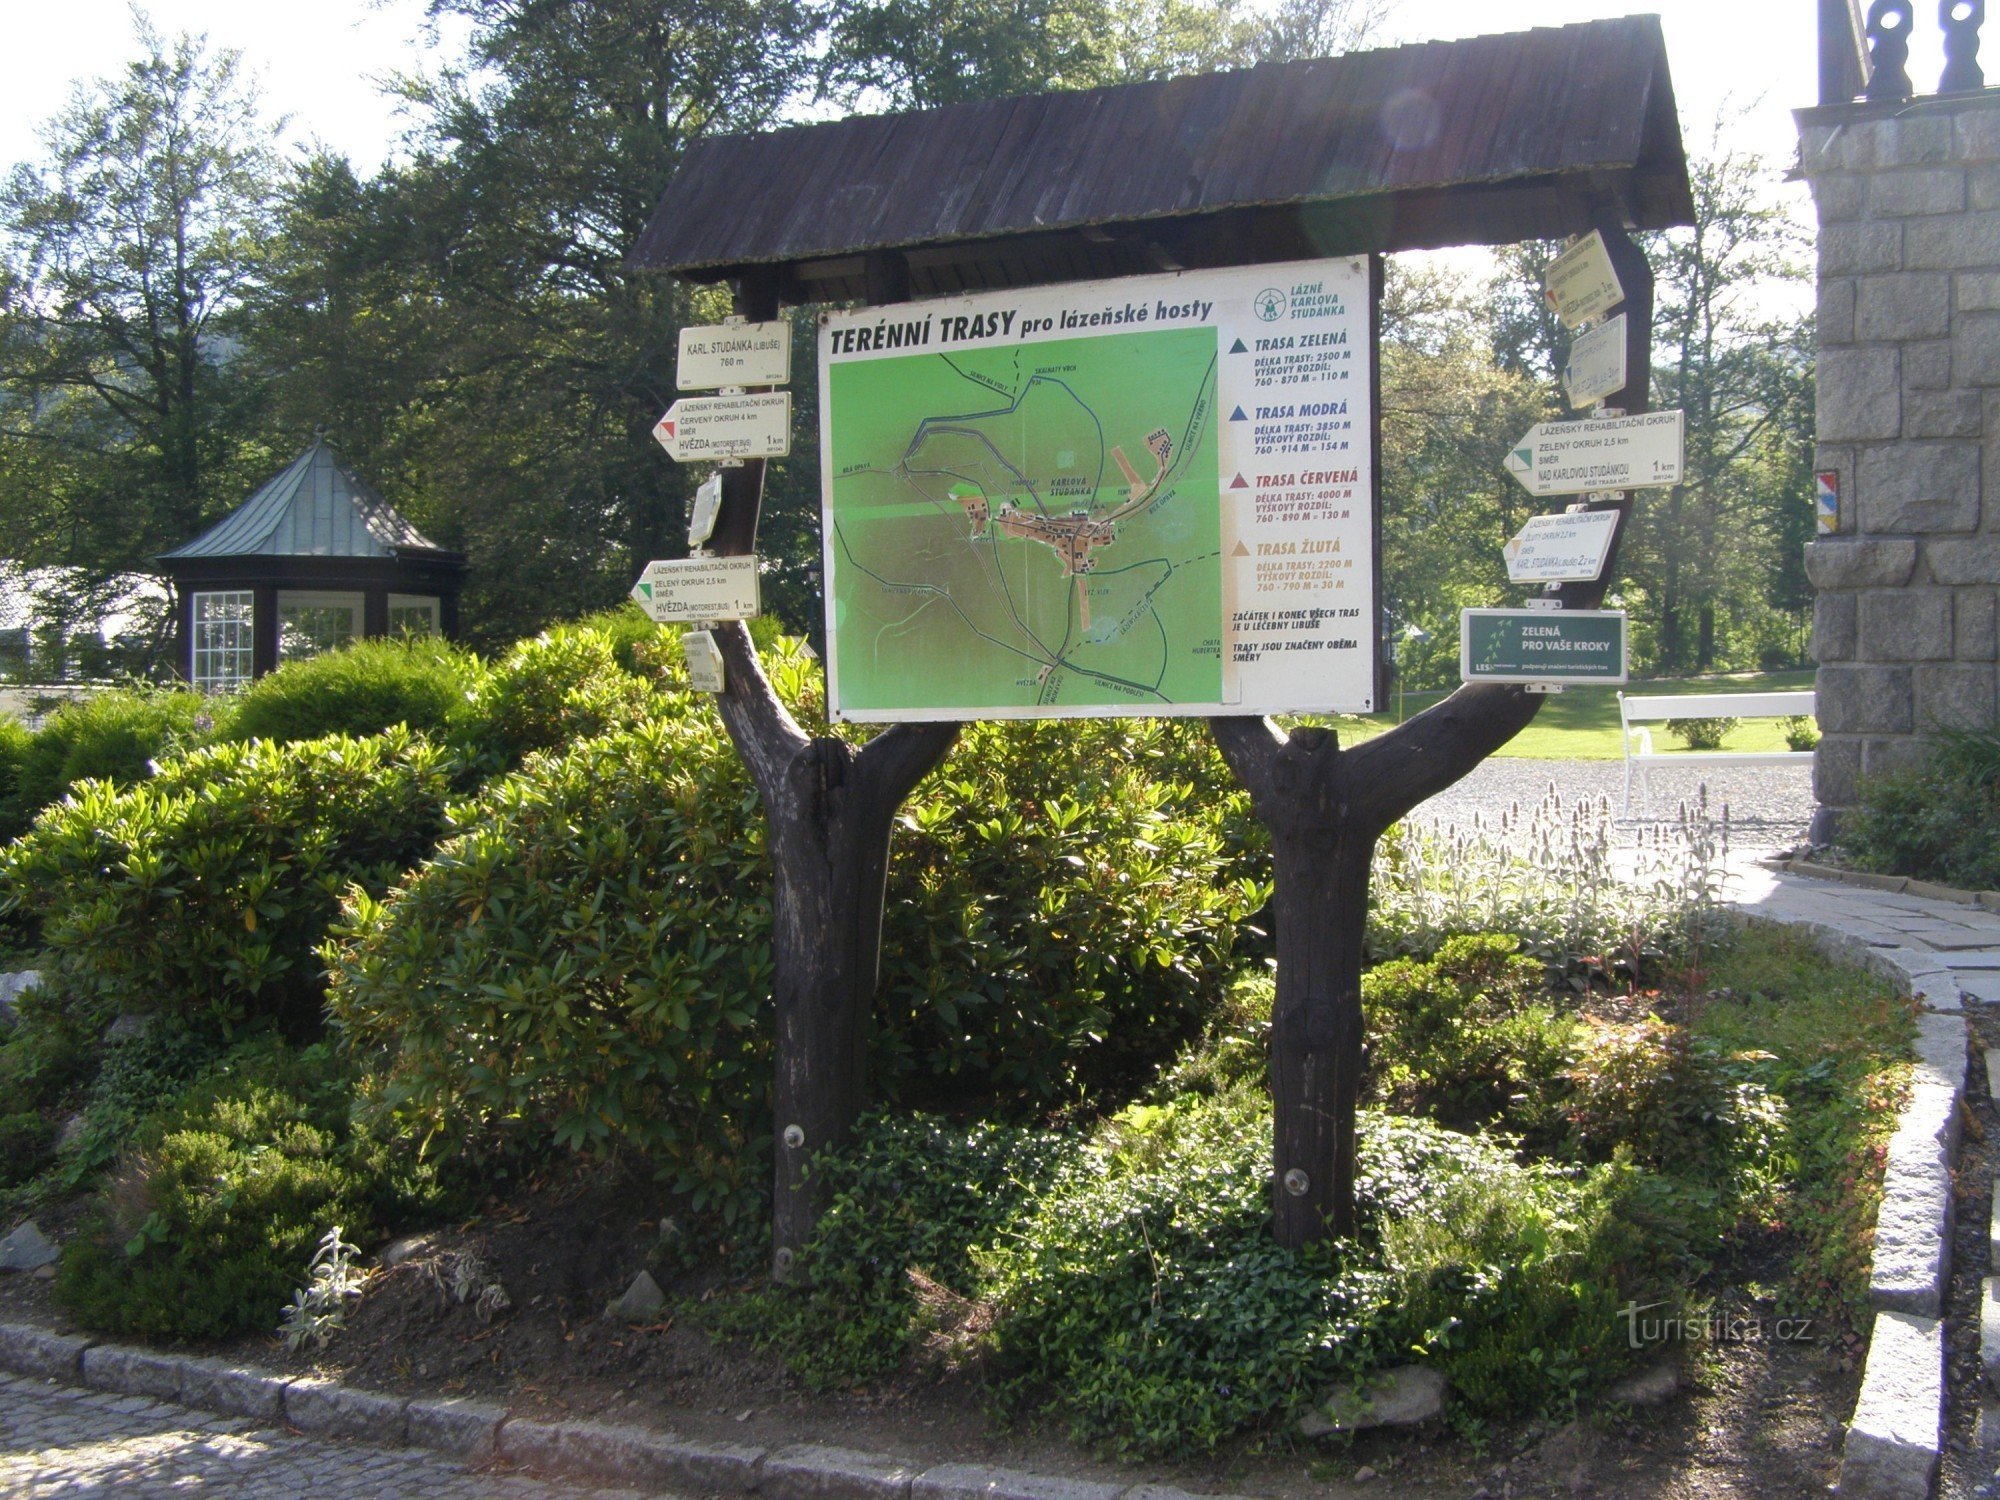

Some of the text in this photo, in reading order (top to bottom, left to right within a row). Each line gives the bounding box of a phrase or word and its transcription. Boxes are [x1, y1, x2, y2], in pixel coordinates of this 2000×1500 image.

[1291, 282, 1323, 296] LÁZNĚ
[1291, 294, 1338, 307] KARLOVA
[831, 300, 1213, 355] TERÉNNÍ TRASY pro lázeňské hosty
[687, 338, 780, 355] KARL. STUDÁNKA (LIBUŠE)
[1255, 328, 1347, 352] TRASA ZELENÁ
[720, 358, 734, 366] 760
[1254, 351, 1351, 367] DÉLKA TRASY: 2500 M
[1254, 362, 1331, 377] VÝŠKOVÝ ROZDÍL:
[1254, 371, 1349, 387] 760 870 M 110 M
[713, 399, 760, 410] REHABILITAČNÍ
[761, 398, 784, 406] OKRUH
[1255, 398, 1347, 420] TRASA MODRÁ
[680, 414, 712, 425] ČERVENÝ
[714, 414, 740, 423] OKRUH
[1540, 415, 1676, 436] LÁZEŇSKÝ REHABILITAČNÍ OKRUH
[680, 427, 696, 435] SMĚR
[1254, 421, 1351, 435] DÉLKA TRASY: 3850 M
[679, 438, 710, 450] HVĚZDA
[767, 435, 771, 445] 1
[1254, 431, 1331, 445] VÝŠKOVÝ ROZDÍL:
[1539, 437, 1629, 452] ZELENÝ OKRUH 2,5 km
[1254, 441, 1349, 455] 760 914 M 154 M
[1538, 455, 1559, 465] SMĚR
[1255, 467, 1358, 488] TRASA ČERVENÁ
[1538, 460, 1675, 481] NAD KARLOVOU STUDÁNKOU 1 km
[1050, 477, 1087, 487] KARLOVA
[1255, 489, 1352, 503] DÉLKA TRASY: 4000 M
[1256, 510, 1350, 523] 760 890 M 130 M
[1256, 537, 1341, 556] TRASA ŽLUTÁ
[684, 562, 728, 572] REHABILITAČNÍ
[1286, 561, 1315, 571] TRASY:
[1317, 560, 1341, 569] 2200
[1344, 559, 1353, 568] M
[655, 579, 680, 588] ZELENÝ
[681, 578, 705, 586] OKRUH
[706, 578, 716, 586] 2,5
[1257, 580, 1344, 592] 760 790 M 30 M
[656, 589, 674, 598] SMĚR
[656, 601, 689, 613] HVĚZDA
[735, 599, 739, 609] 1
[1233, 610, 1269, 622] ZAČÁTEK
[1278, 610, 1307, 619] KONEC
[1309, 608, 1336, 618] VŠECH
[1338, 608, 1360, 617] TRAS
[1233, 618, 1320, 631] JE U LÉČEBNY LIBUŠE
[1522, 625, 1561, 637] ZELENÁ
[1233, 638, 1357, 652] TRASY JSOU ZNAČENY OBĚMA
[1522, 639, 1610, 651] PRO VAŠE KROKY
[1233, 651, 1261, 662] SMĚRY
